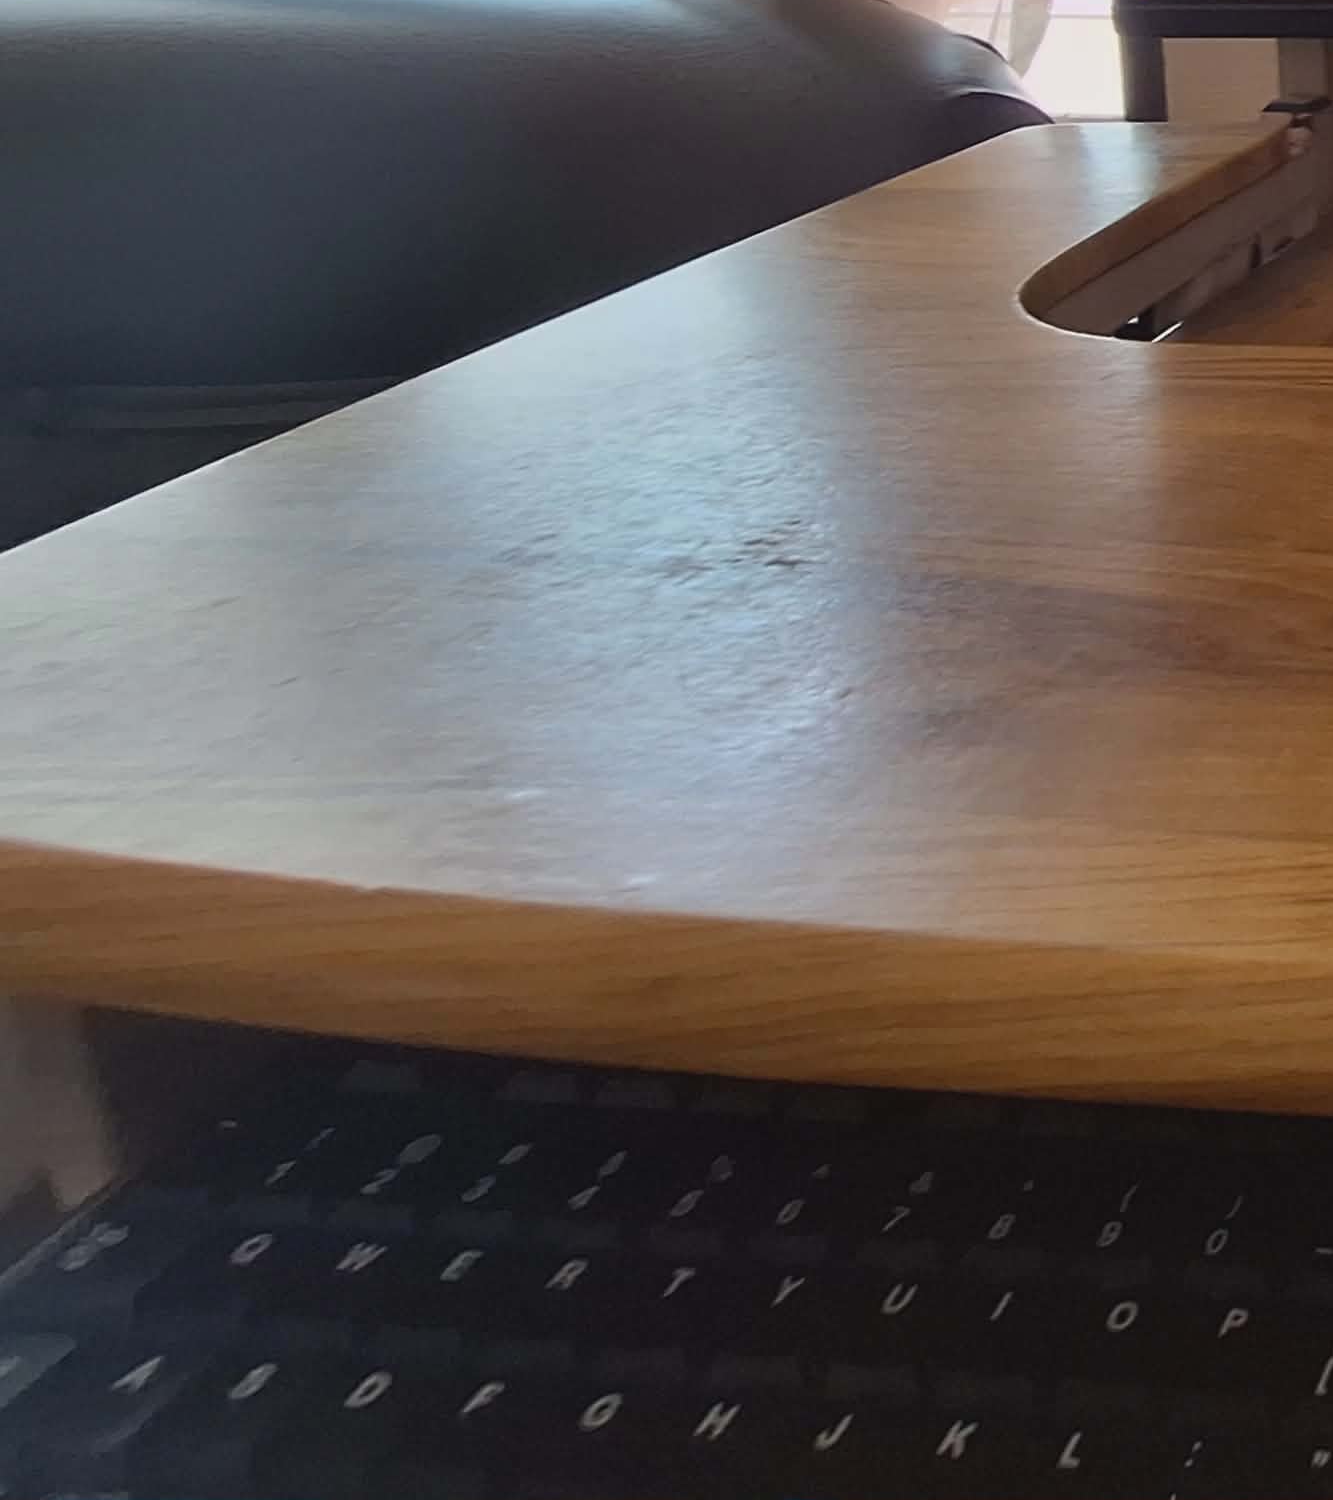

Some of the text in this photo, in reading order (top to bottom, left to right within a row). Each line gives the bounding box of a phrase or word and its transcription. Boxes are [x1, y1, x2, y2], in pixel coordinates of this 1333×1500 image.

[1218, 1307, 1249, 1336] P
[694, 1402, 741, 1439] H
[813, 1413, 853, 1450] J
[936, 1420, 978, 1460] K
[1055, 1432, 1081, 1468] L
